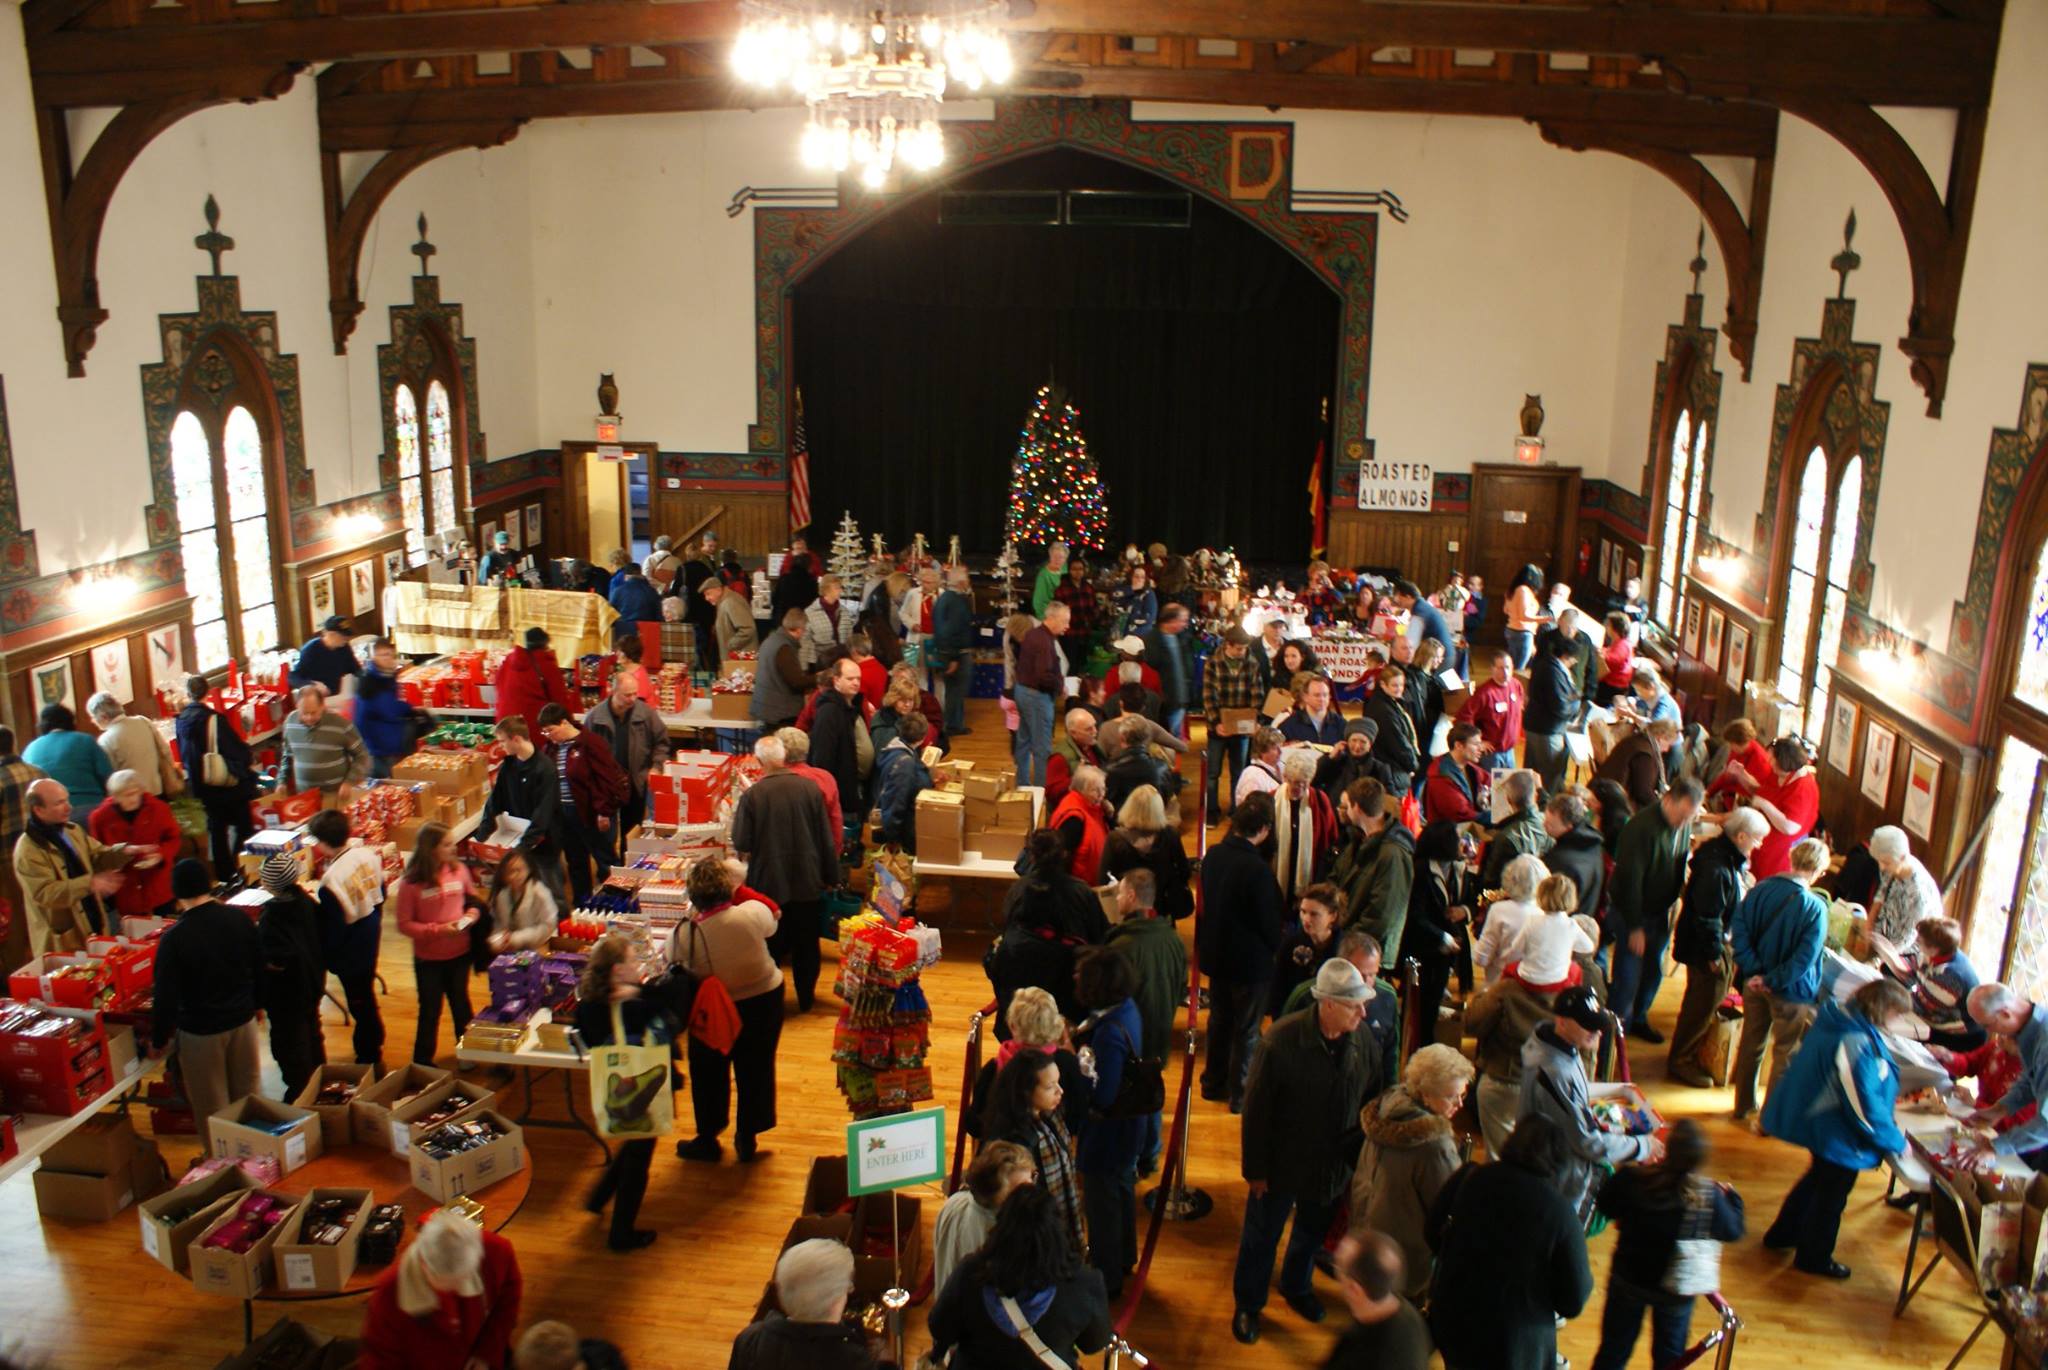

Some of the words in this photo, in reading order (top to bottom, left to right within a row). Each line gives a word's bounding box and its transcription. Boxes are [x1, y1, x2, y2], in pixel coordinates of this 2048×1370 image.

[1362, 463, 1430, 480] ROASTED
[1360, 489, 1428, 506] ALMONDS
[1310, 645, 1339, 654] MAN
[1319, 657, 1336, 666] ON
[1340, 657, 1366, 666] ROAS
[1331, 669, 1361, 678] ONDS
[867, 1153, 900, 1169] ENTER
[902, 1148, 926, 1163] HERE
